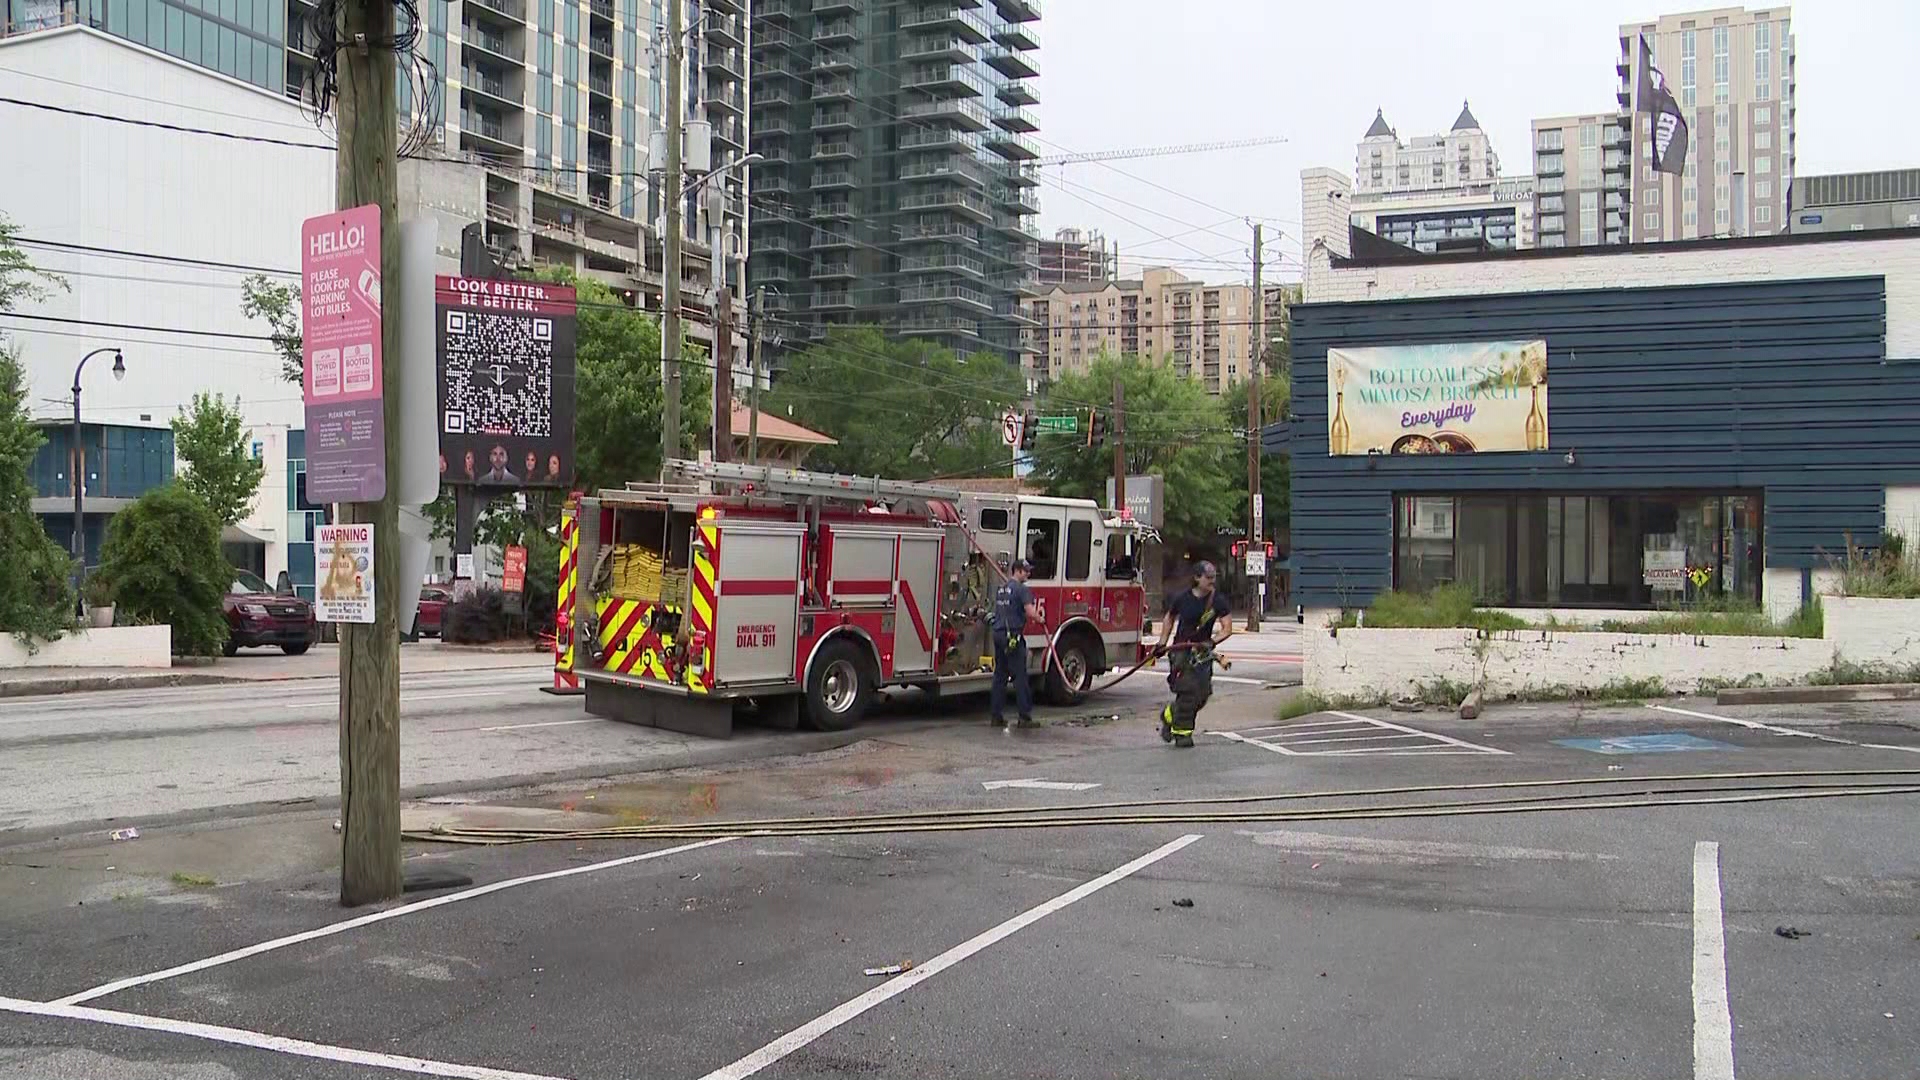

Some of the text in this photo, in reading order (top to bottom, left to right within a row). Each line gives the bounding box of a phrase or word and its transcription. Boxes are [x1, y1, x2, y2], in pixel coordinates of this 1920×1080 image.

[310, 225, 365, 256] HELLO!
[310, 268, 339, 283] PLEASE
[310, 278, 350, 295] LOOK FOR
[450, 279, 550, 300] LOOK BETTER.
[311, 291, 346, 307] PARKING
[461, 293, 539, 312] BE BETTER.
[311, 302, 352, 318] LOT RULES.
[315, 357, 370, 371] TOWED BOOTED
[1369, 364, 1500, 385] BOTTOMLESS
[1359, 384, 1519, 404] MIMOSA BRUNCH
[1401, 402, 1477, 428] Everyday
[321, 528, 368, 542] WARNING
[737, 624, 776, 634] EMERGENCY
[736, 633, 776, 648] DIAL 911
[639, 643, 652, 667] 15
